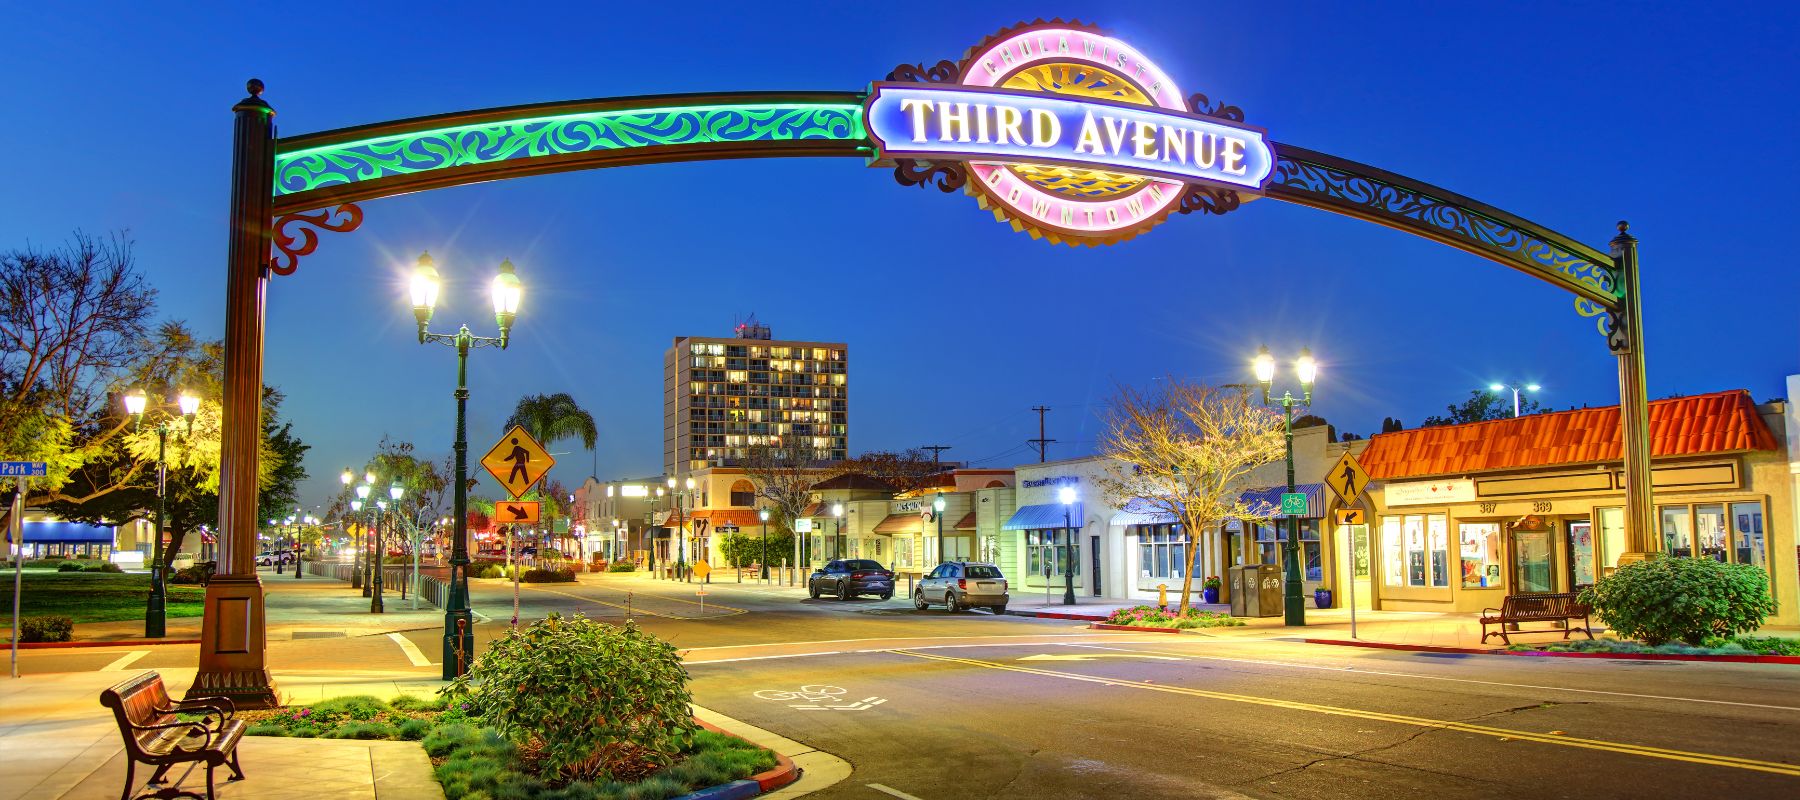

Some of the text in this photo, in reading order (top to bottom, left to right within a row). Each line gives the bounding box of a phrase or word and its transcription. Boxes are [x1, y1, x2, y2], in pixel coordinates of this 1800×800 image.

[983, 35, 1162, 98] CHULA VISTA
[901, 99, 1248, 177] THIRD AVENUE
[986, 169, 1165, 226] DOWNTOWN
[2, 463, 26, 474] Park
[1480, 503, 1496, 513] 367
[1533, 502, 1552, 512] 369
